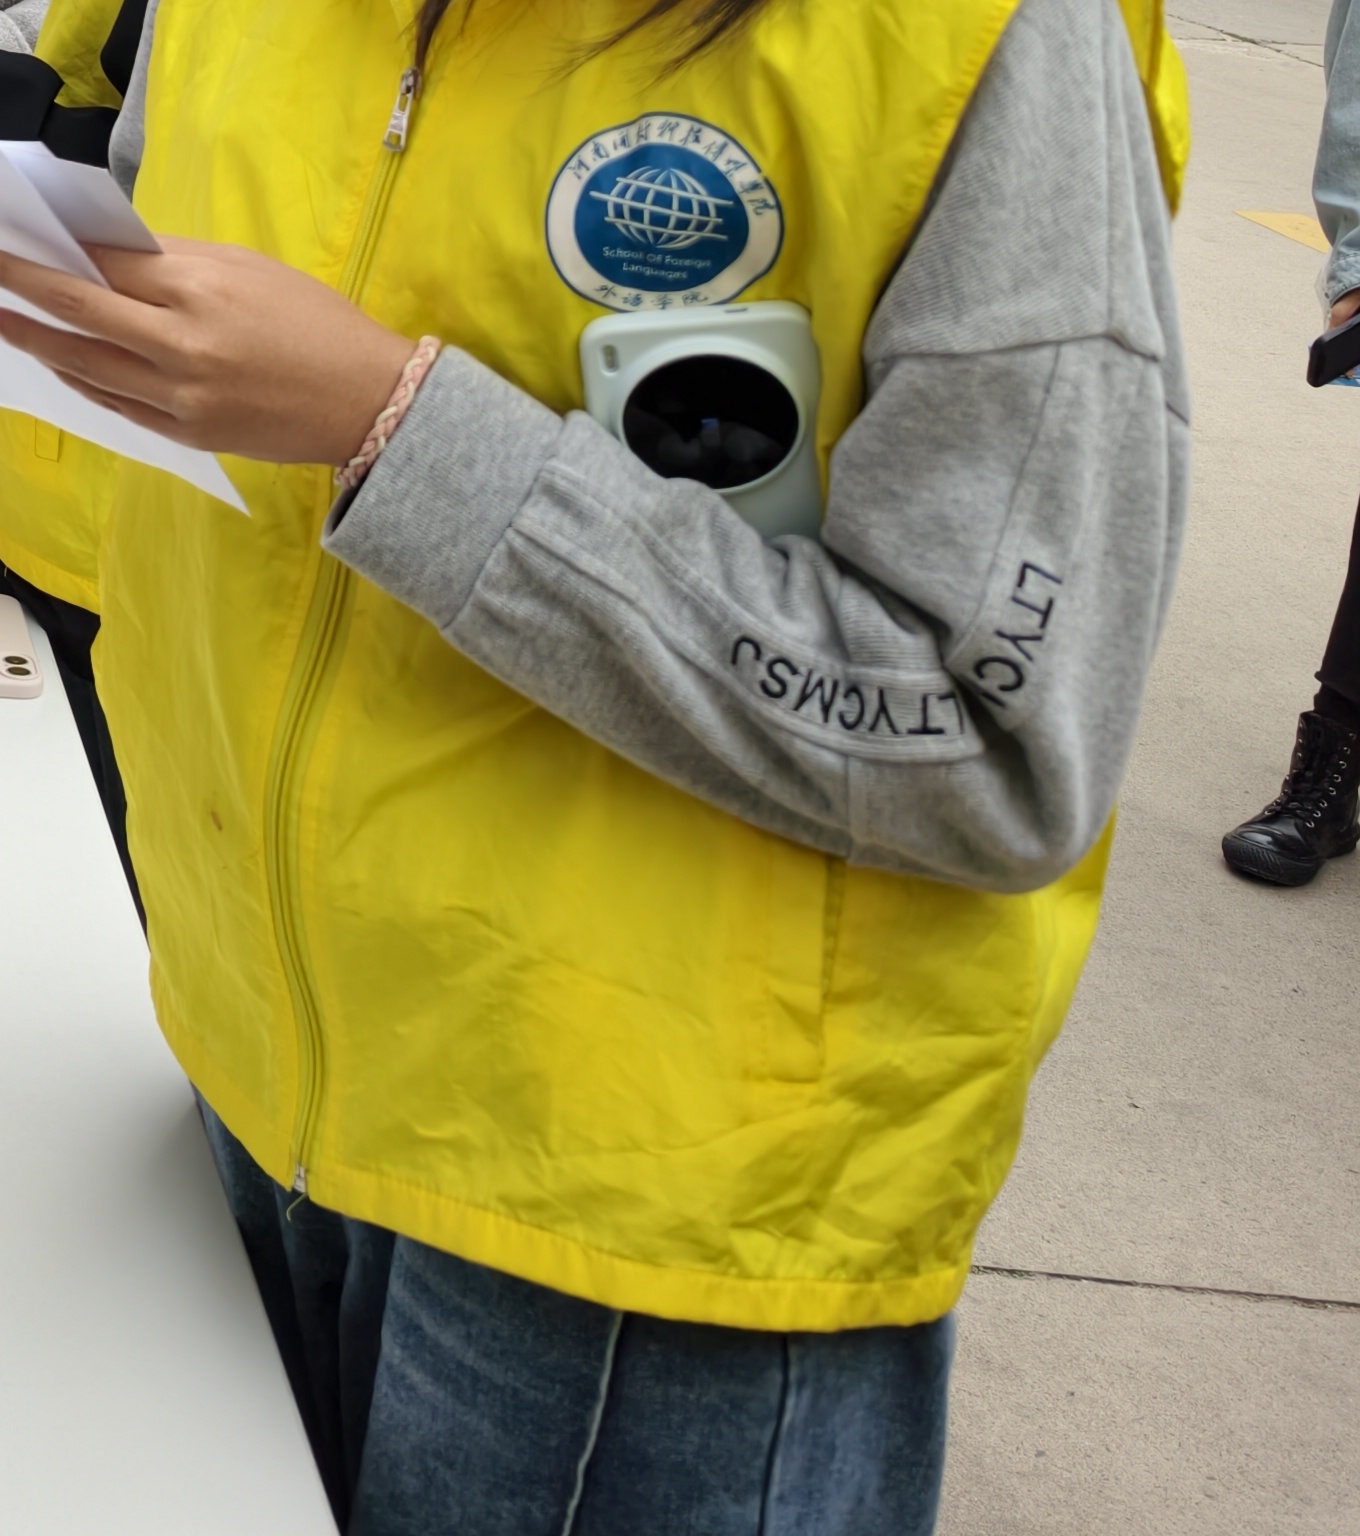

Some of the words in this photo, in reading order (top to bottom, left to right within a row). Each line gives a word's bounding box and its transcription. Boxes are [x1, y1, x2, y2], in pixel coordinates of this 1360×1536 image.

[602, 245, 644, 259] School
[622, 262, 688, 280] Languages
[973, 561, 1062, 709] LTYC
